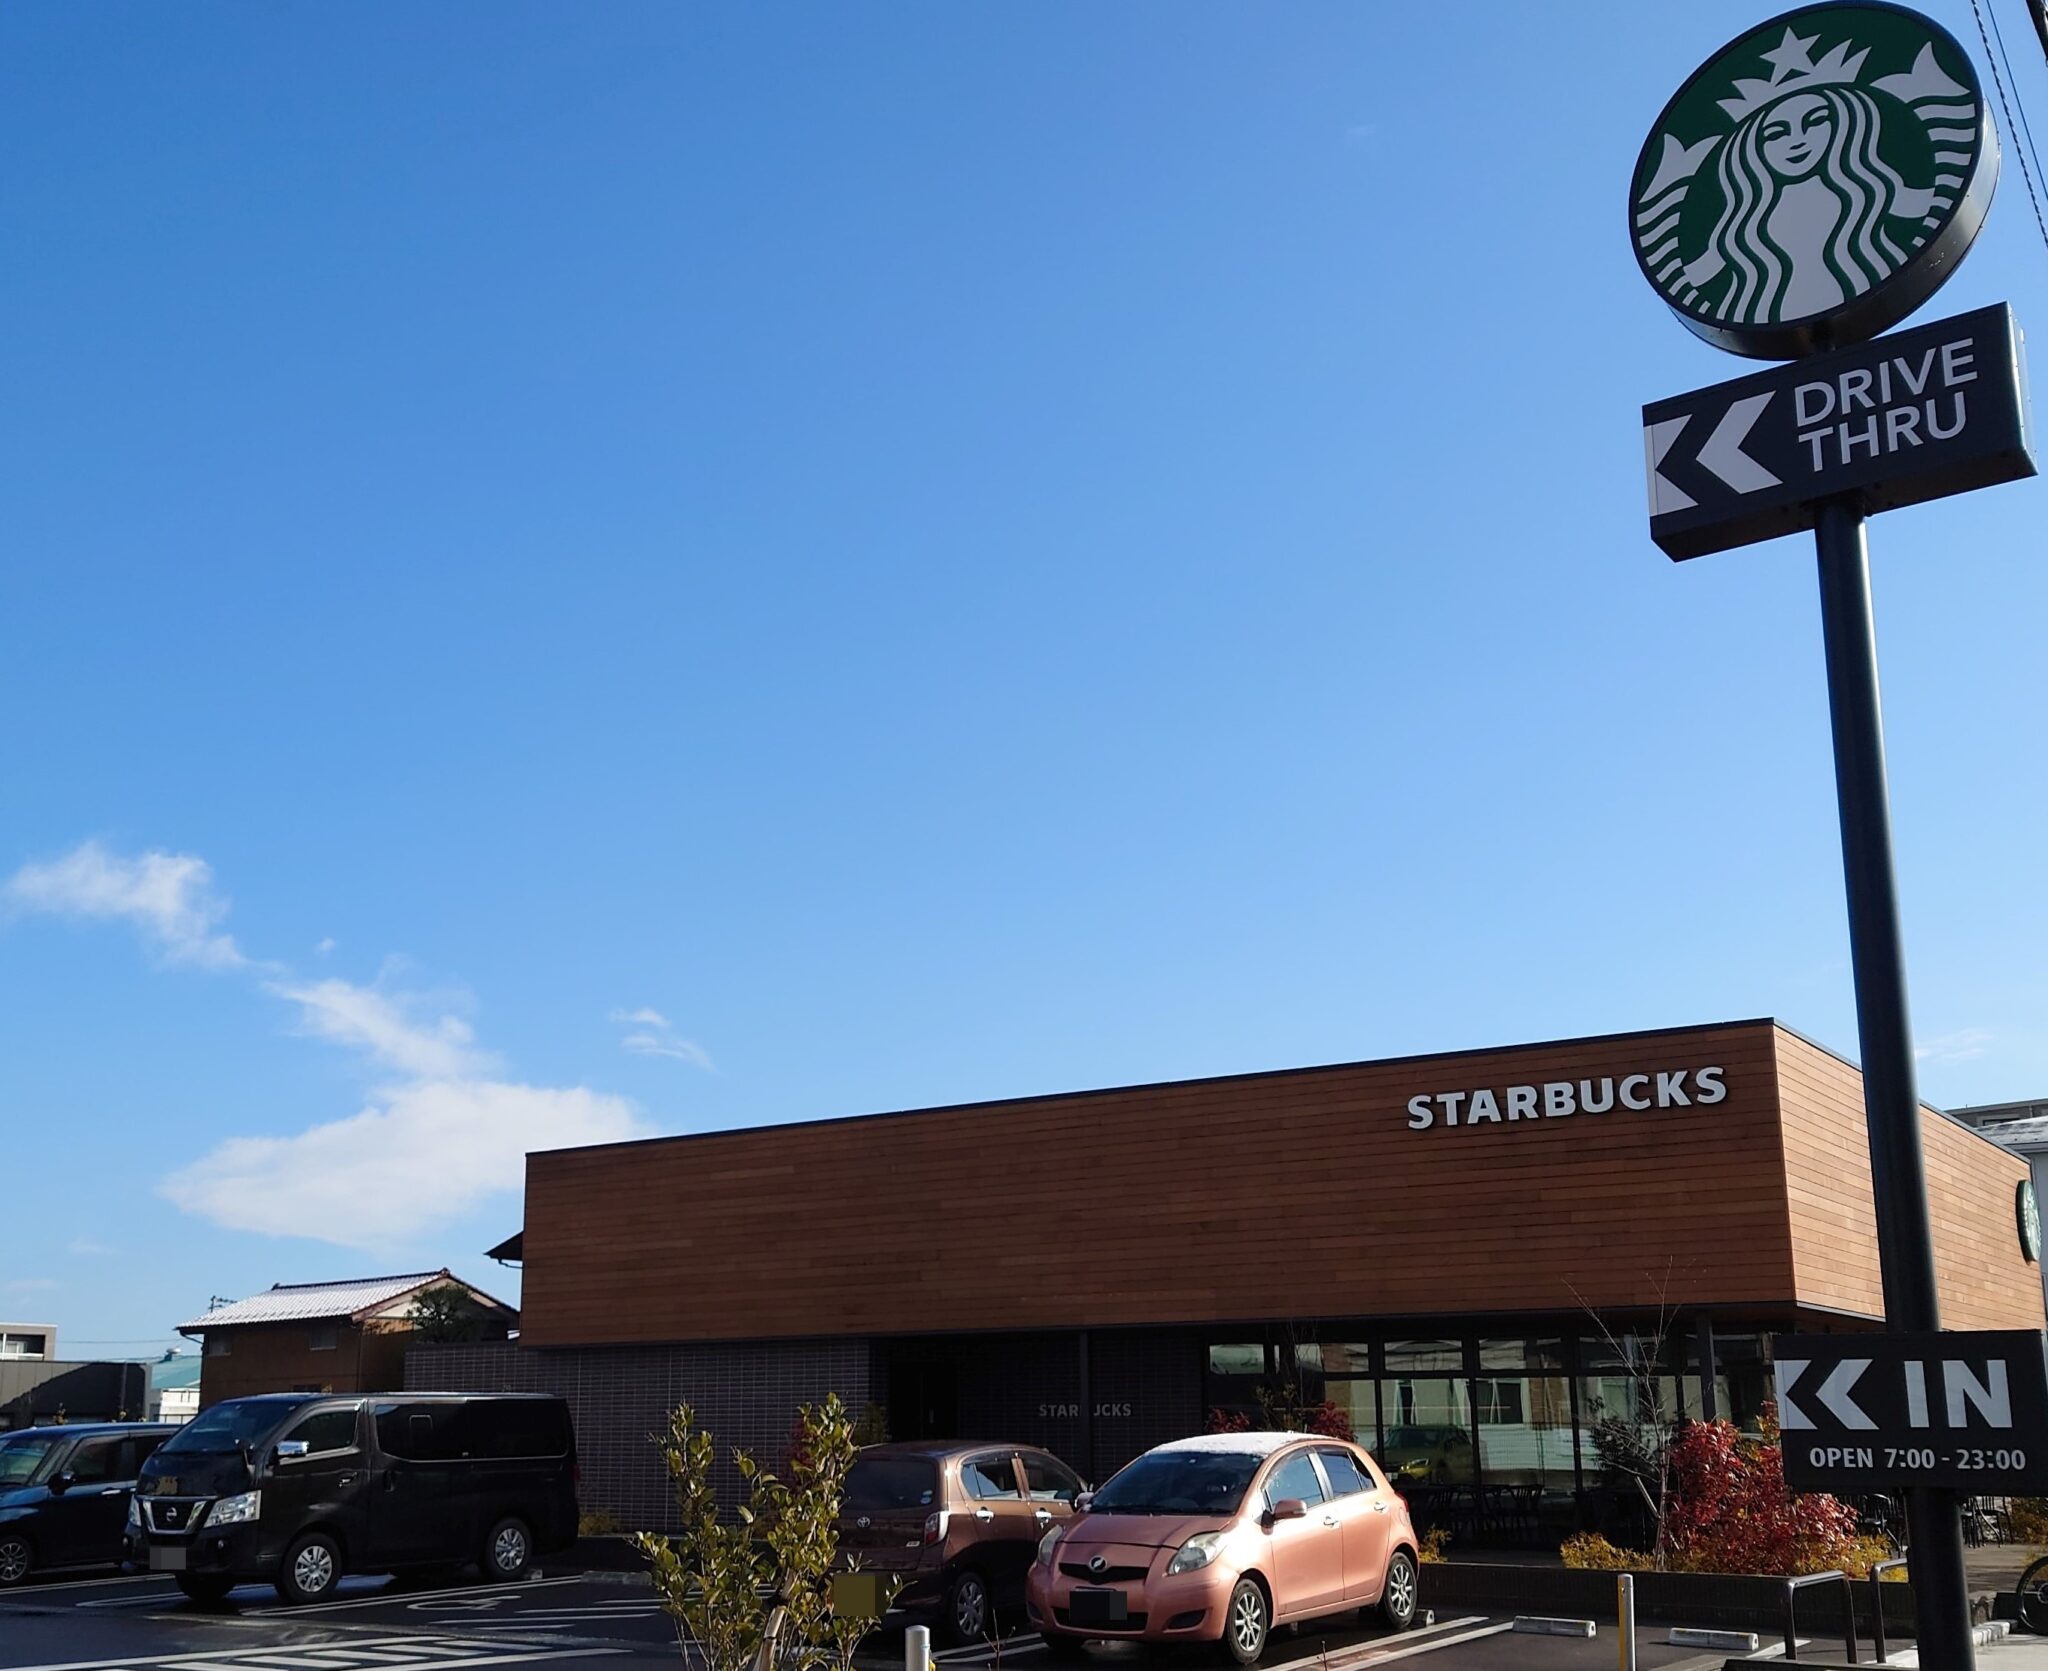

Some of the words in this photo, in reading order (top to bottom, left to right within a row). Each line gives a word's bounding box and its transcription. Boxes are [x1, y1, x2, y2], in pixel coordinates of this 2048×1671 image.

[1794, 337, 1979, 427] DRIVE
[1798, 391, 1967, 473] THRU
[1407, 1066, 1728, 1130] STARBUCKS
[1039, 1403, 1132, 1417] STARUCKS
[1903, 1359, 2013, 1428] IN
[1809, 1447, 1874, 1469] OPEN
[1884, 1448, 1936, 1469] 7:00
[1956, 1449, 2026, 1470] 23:00
